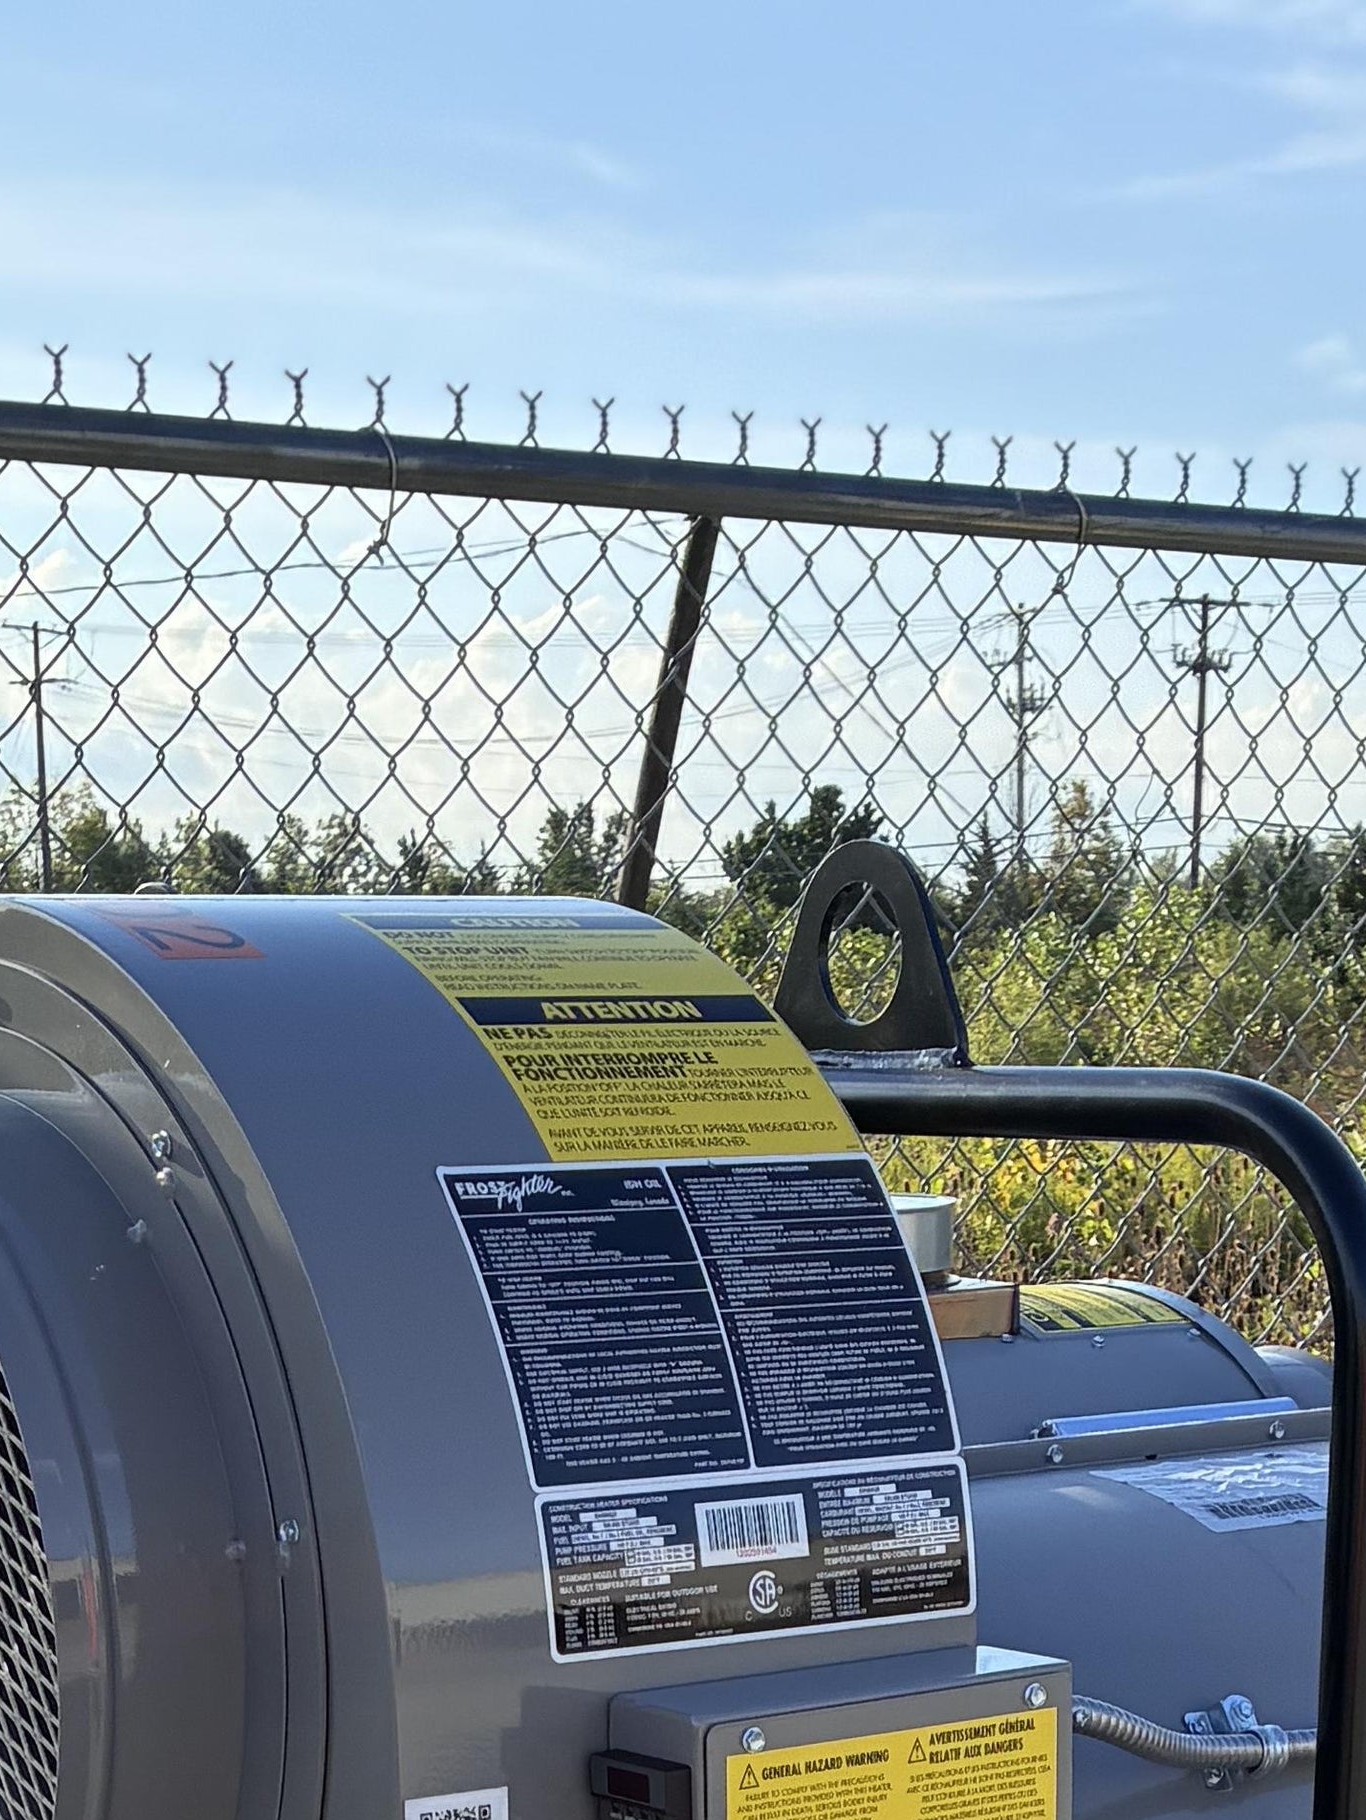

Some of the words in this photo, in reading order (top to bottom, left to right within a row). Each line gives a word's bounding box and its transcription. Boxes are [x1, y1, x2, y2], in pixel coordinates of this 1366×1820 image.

[403, 946, 430, 954] TO
[433, 946, 485, 954] STOP
[490, 946, 529, 954] UNIT
[542, 1001, 702, 1020] ATTENTION
[485, 1027, 513, 1040] NE
[517, 1027, 553, 1040] PAS
[503, 1055, 558, 1067] POUR
[562, 1053, 694, 1065] INTERROMPRE
[697, 1052, 718, 1063] LE
[513, 1066, 686, 1081] FONCTIONNEMENT
[455, 1181, 507, 1195] FROST
[929, 1724, 996, 1745] AVERTISSEMENT
[999, 1715, 1035, 1735] GÉNÉRAL
[929, 1747, 960, 1764] RELATIF
[963, 1744, 981, 1759] AUX
[984, 1738, 1023, 1755] DANGERS
[762, 1762, 801, 1780] GENERAL
[805, 1755, 841, 1774] HAZARD
[845, 1749, 888, 1768] WARNING
